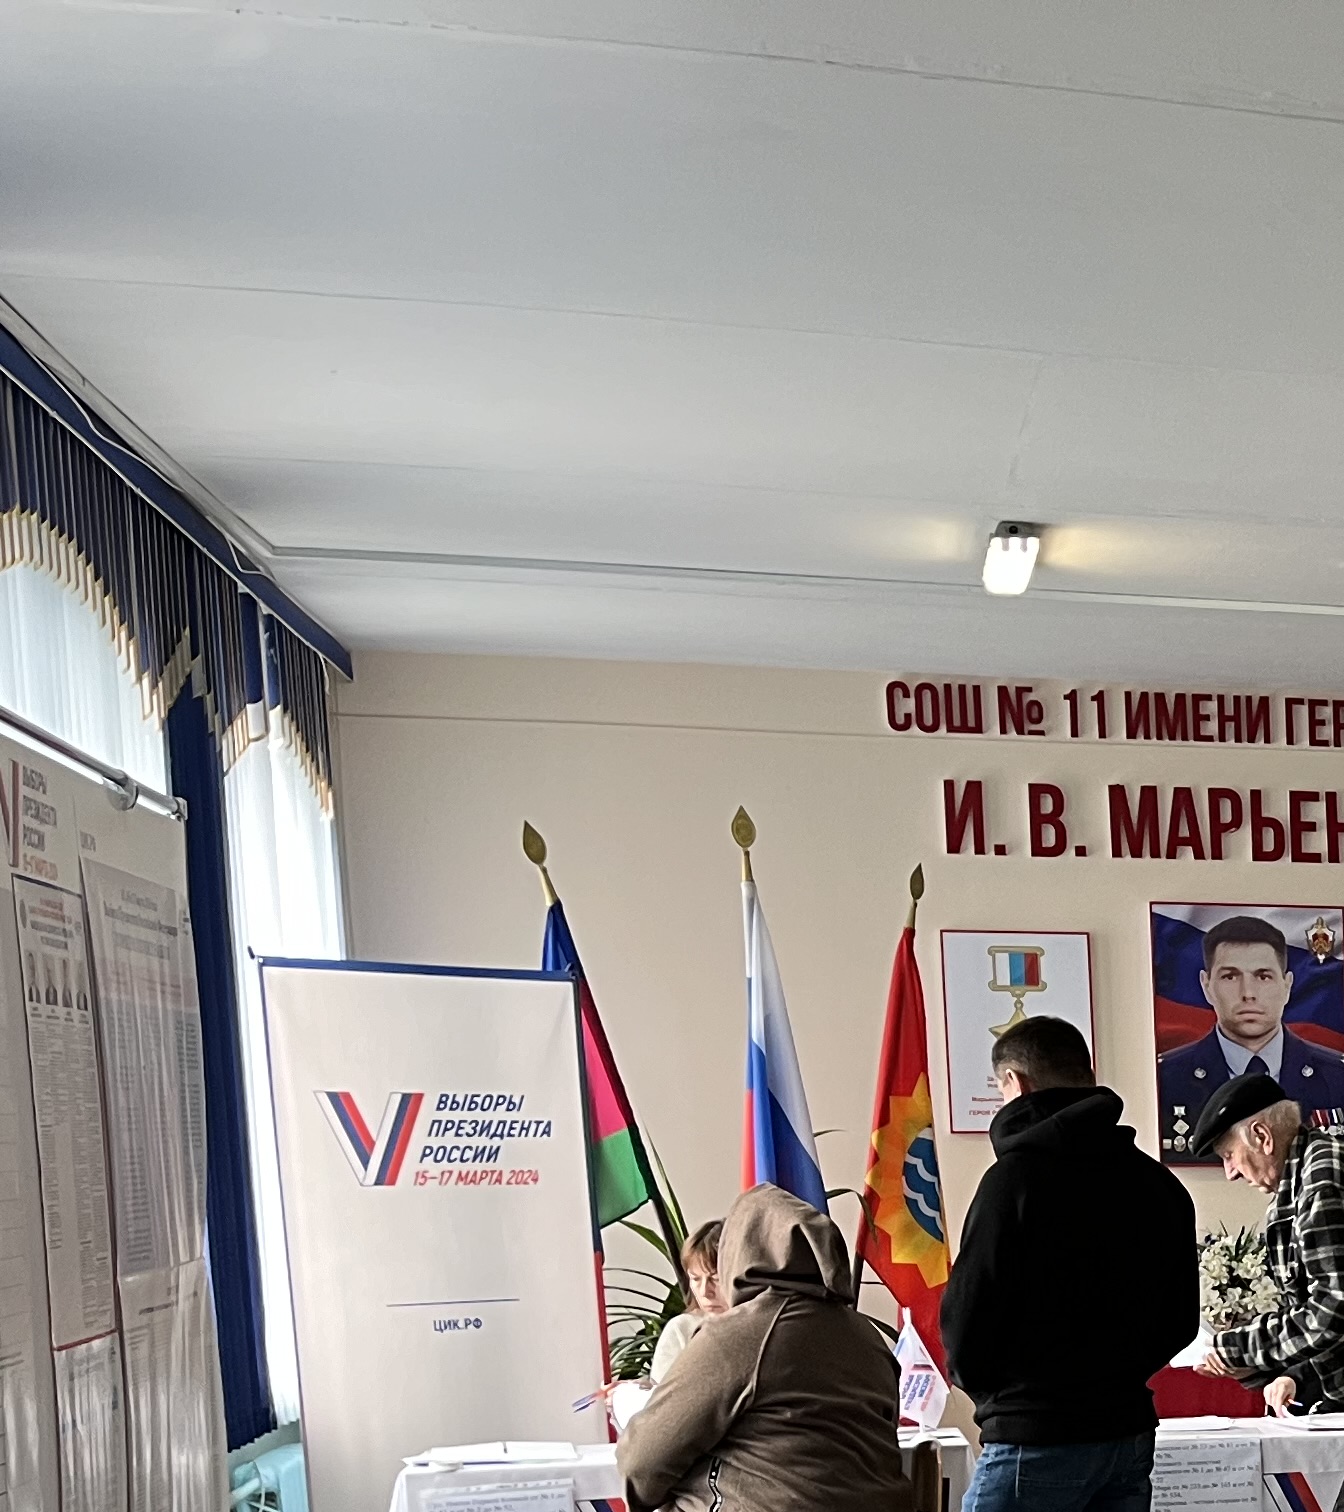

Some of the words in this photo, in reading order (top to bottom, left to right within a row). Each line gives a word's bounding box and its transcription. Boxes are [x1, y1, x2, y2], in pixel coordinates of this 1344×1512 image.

[885, 680, 984, 735] СОШ
[997, 685, 1046, 737] №
[1124, 691, 1273, 745] ИМЕНИ
[943, 779, 1006, 857] И.
[1028, 782, 1087, 858] В.
[435, 1093, 525, 1112] ВЫБОРЫ
[427, 1119, 552, 1140] ПРЕЗИДЕНТА
[419, 1145, 501, 1164] РОССИИ
[454, 1170, 504, 1186] МАРТА
[505, 1169, 540, 1185] 2024
[432, 1318, 483, 1333] ЦИК.РФ
